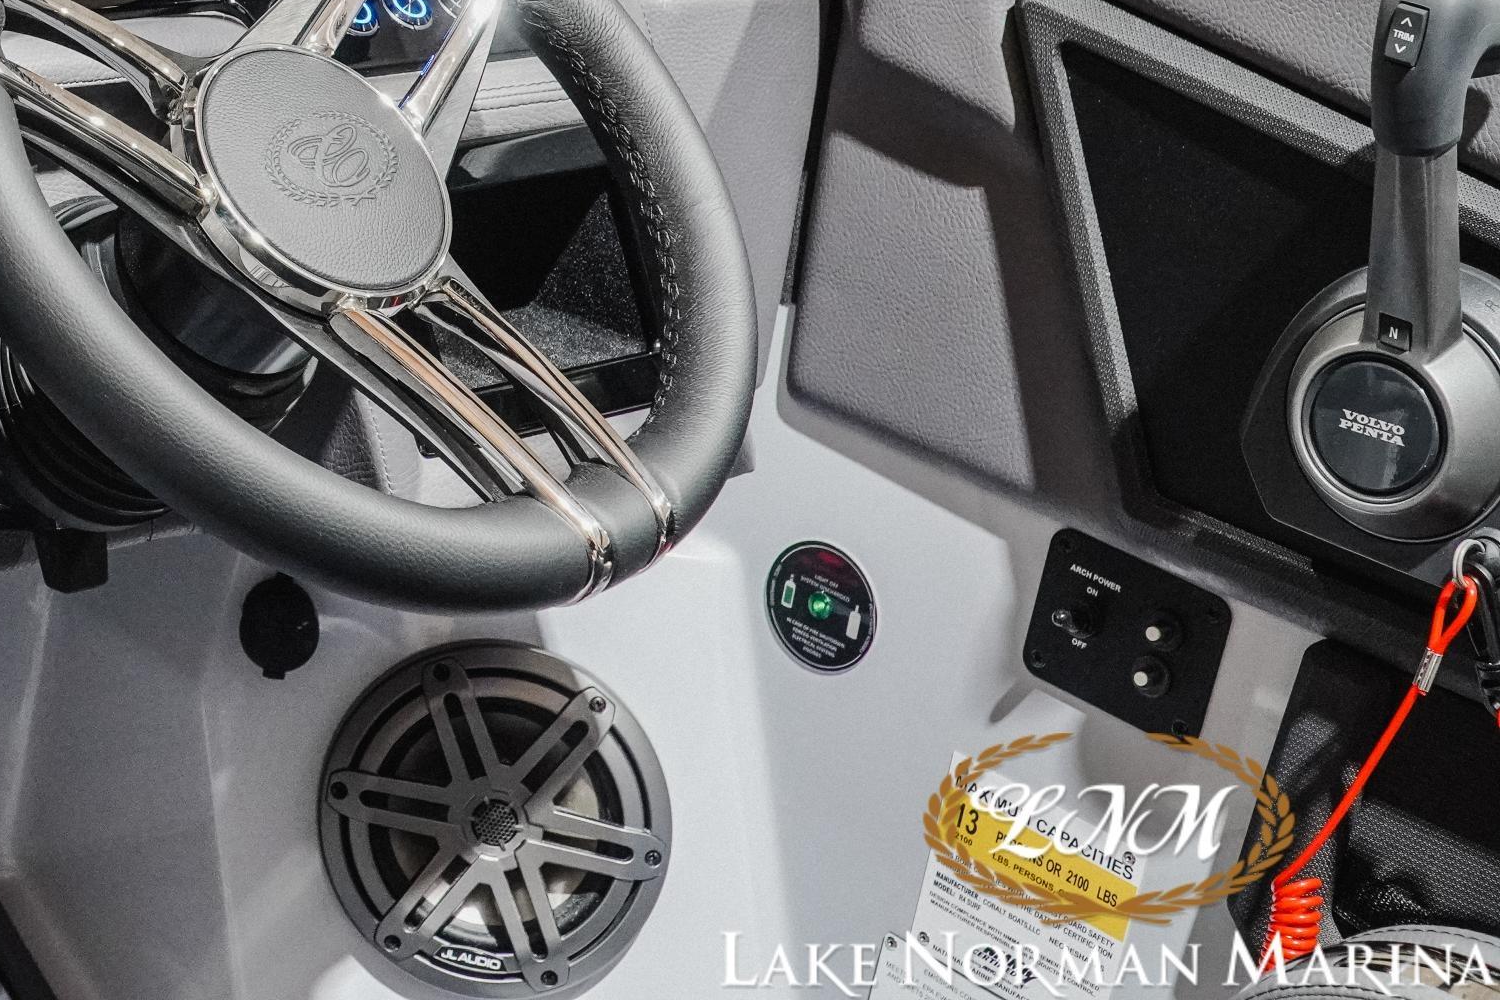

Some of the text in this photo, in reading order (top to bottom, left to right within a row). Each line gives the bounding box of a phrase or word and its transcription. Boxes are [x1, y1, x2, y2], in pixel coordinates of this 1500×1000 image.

[1393, 28, 1416, 44] TRIM
[1388, 326, 1398, 340] N
[1342, 408, 1405, 435] VOLVO
[1339, 418, 1405, 447] PENTA
[1070, 563, 1121, 593] ARCH POWER
[1086, 586, 1098, 597] ON
[1072, 637, 1087, 649] OFF
[955, 832, 1057, 895] 2100 LBS. PERSONS,
[956, 803, 980, 835] 13
[1046, 860, 1062, 877] OR
[1066, 870, 1090, 892] 2100
[1097, 886, 1118, 907] LBS
[933, 880, 955, 896] MODEL:
[967, 899, 981, 910] SURF
[983, 899, 1006, 916] COBALT
[1088, 930, 1114, 948] SAFETY
[441, 949, 501, 970] JL AUDIO
